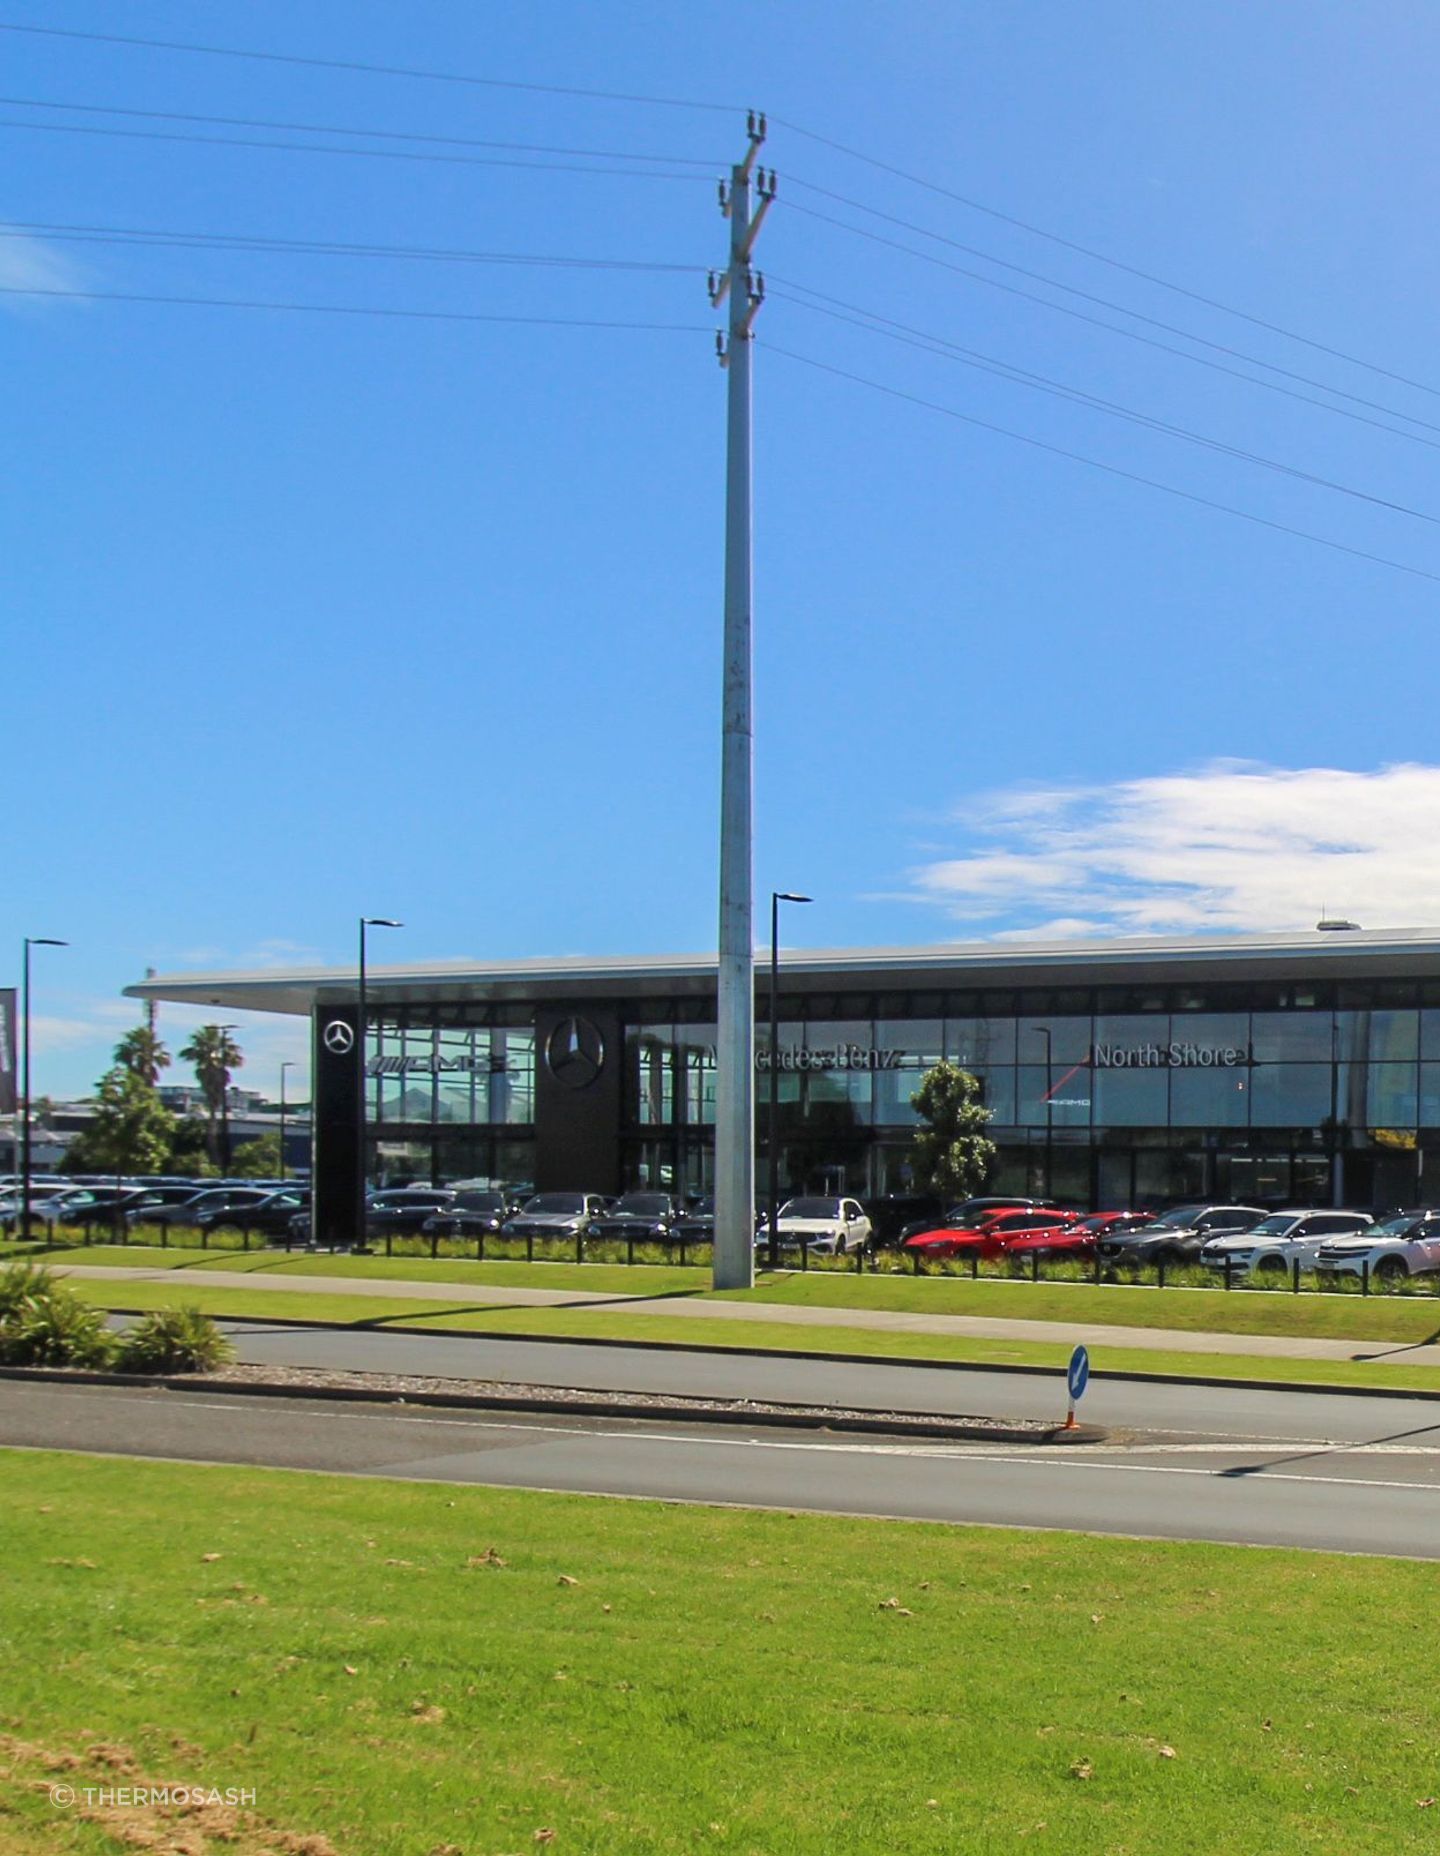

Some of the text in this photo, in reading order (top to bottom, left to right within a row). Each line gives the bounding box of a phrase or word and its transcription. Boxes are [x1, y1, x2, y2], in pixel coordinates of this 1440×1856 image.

[708, 1043, 895, 1070] cedes-Benz
[1095, 1042, 1237, 1067] North Shore
